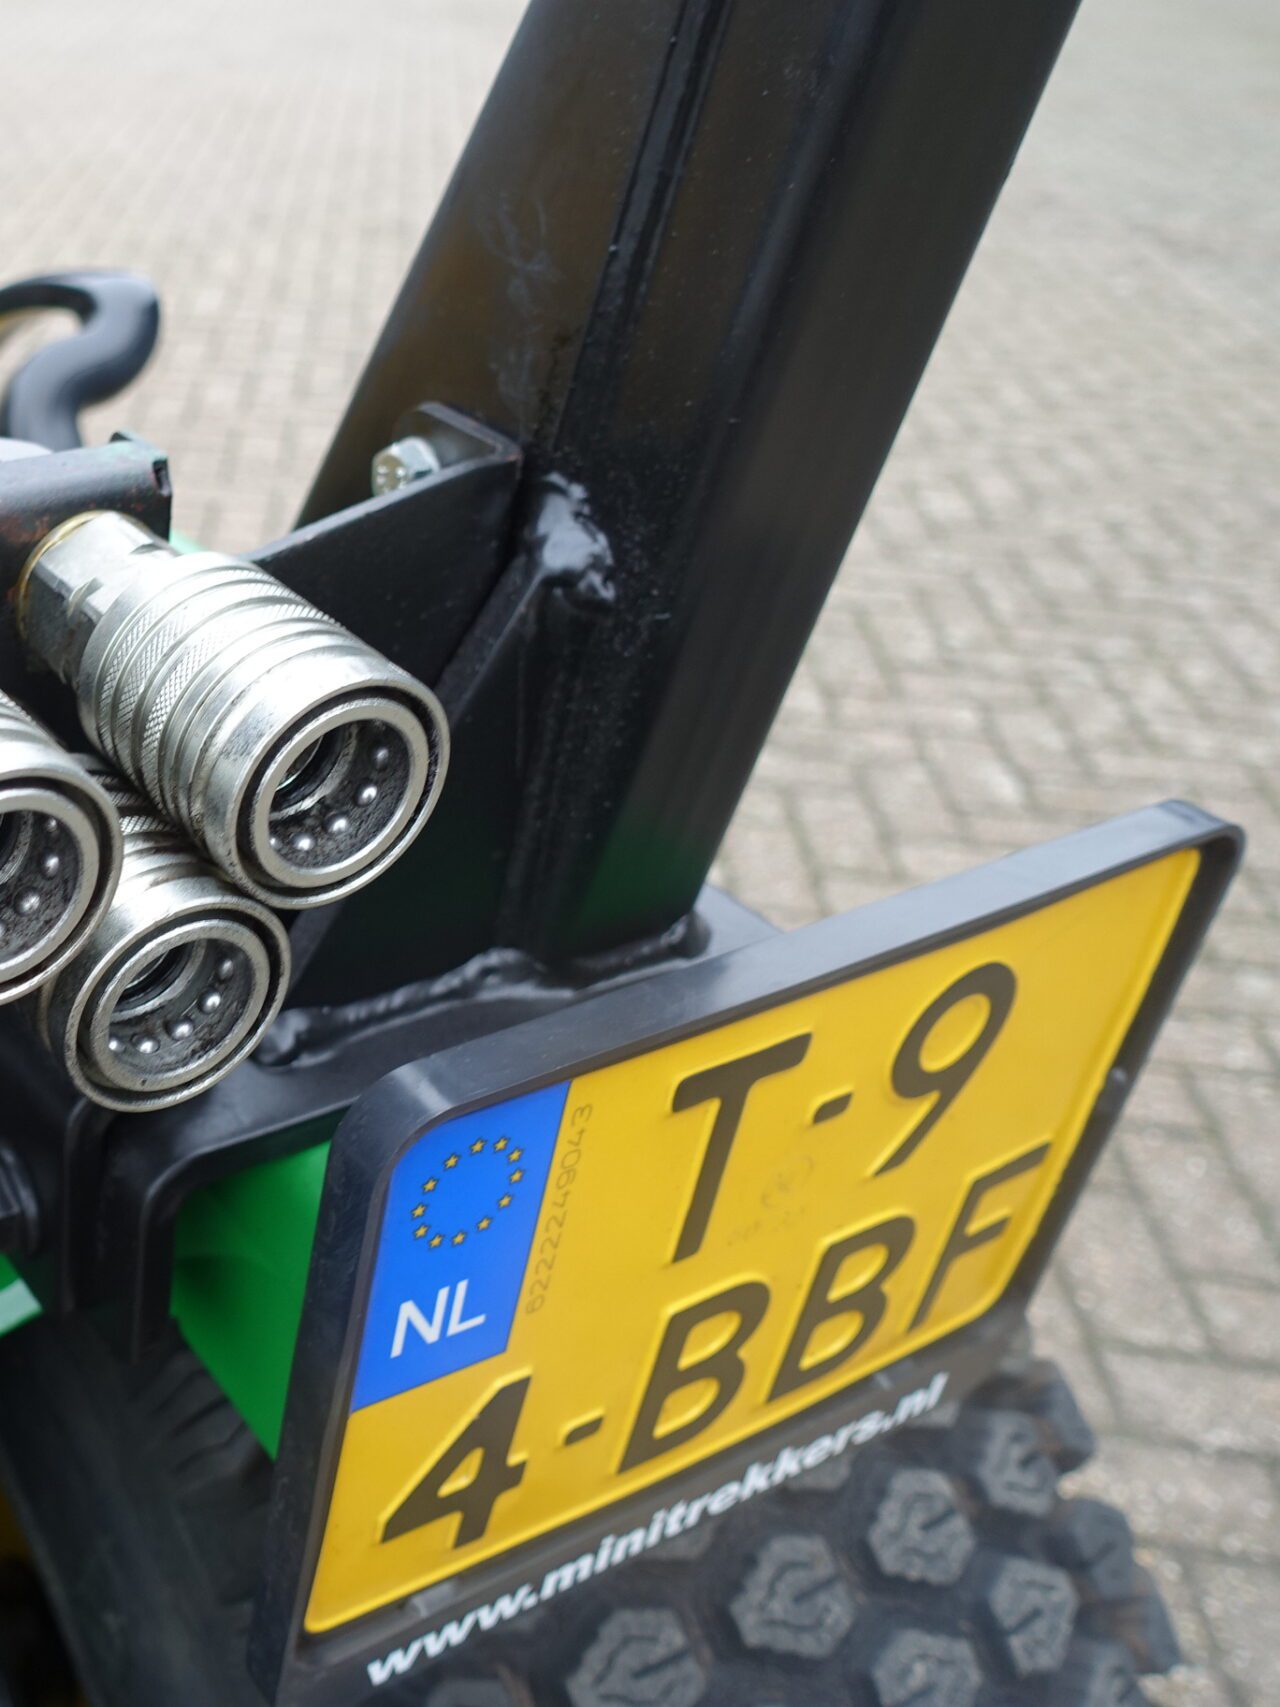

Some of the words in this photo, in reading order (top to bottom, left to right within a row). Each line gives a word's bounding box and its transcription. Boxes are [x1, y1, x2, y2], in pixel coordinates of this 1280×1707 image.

[670, 960, 1018, 1267] T-9
[378, 1140, 1054, 1551] 4-BBF
[389, 1279, 486, 1359] NL
[366, 1372, 949, 1687] www.minitrekkers.nl
